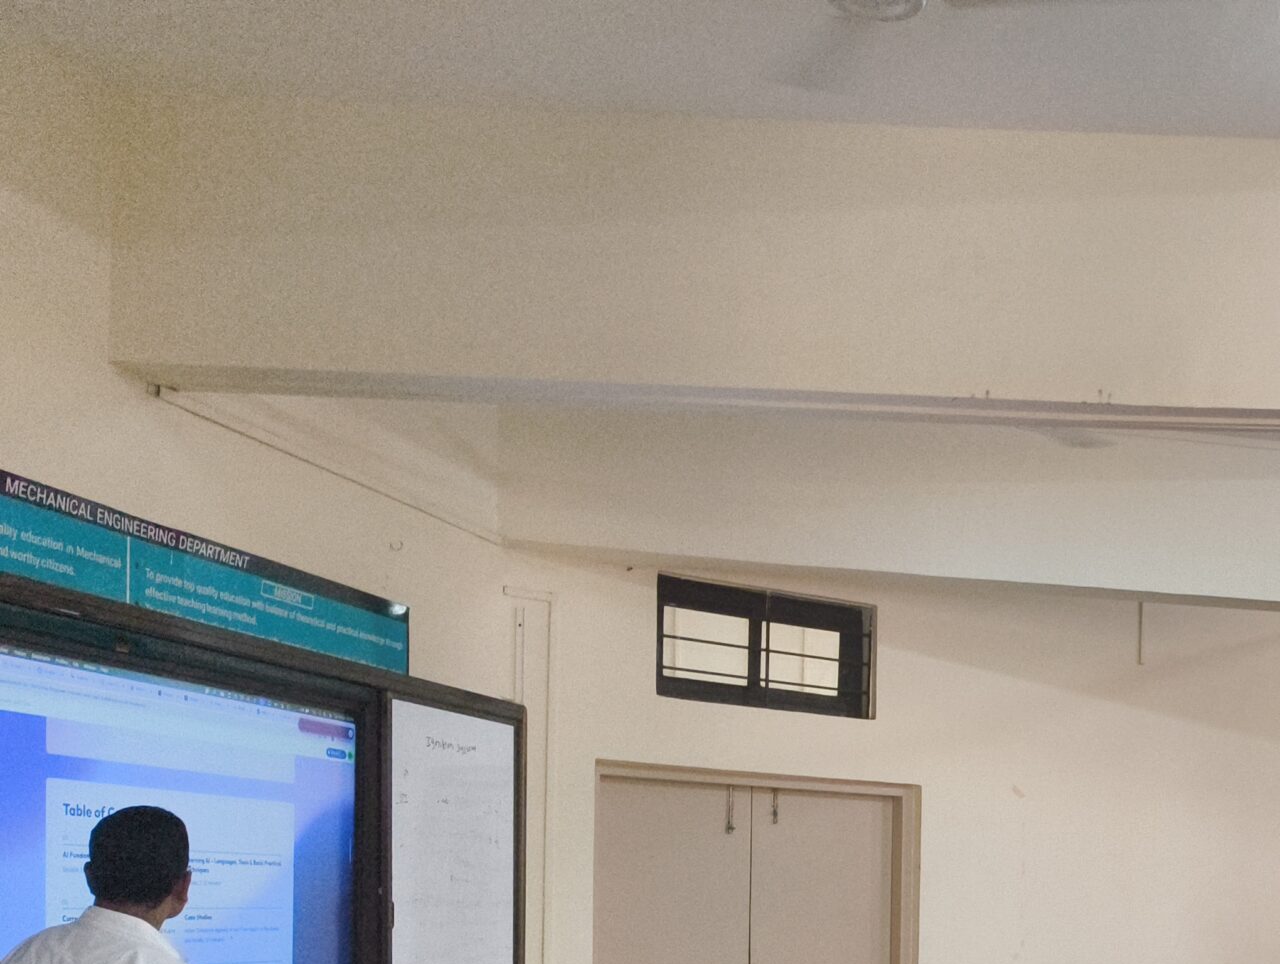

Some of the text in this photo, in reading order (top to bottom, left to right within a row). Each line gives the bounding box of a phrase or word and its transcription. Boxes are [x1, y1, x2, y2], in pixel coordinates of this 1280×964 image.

[5, 476, 249, 569] MECHANICAL ENGINEERING DEPARTMENT
[0, 523, 122, 569] ality education in Mechanical
[10, 550, 40, 569] worthy
[145, 567, 155, 580] To
[155, 573, 183, 588] provide
[196, 584, 219, 600] quality
[220, 590, 251, 607] education
[145, 586, 177, 604] effective
[63, 803, 92, 818] Table
[94, 806, 105, 818] of
